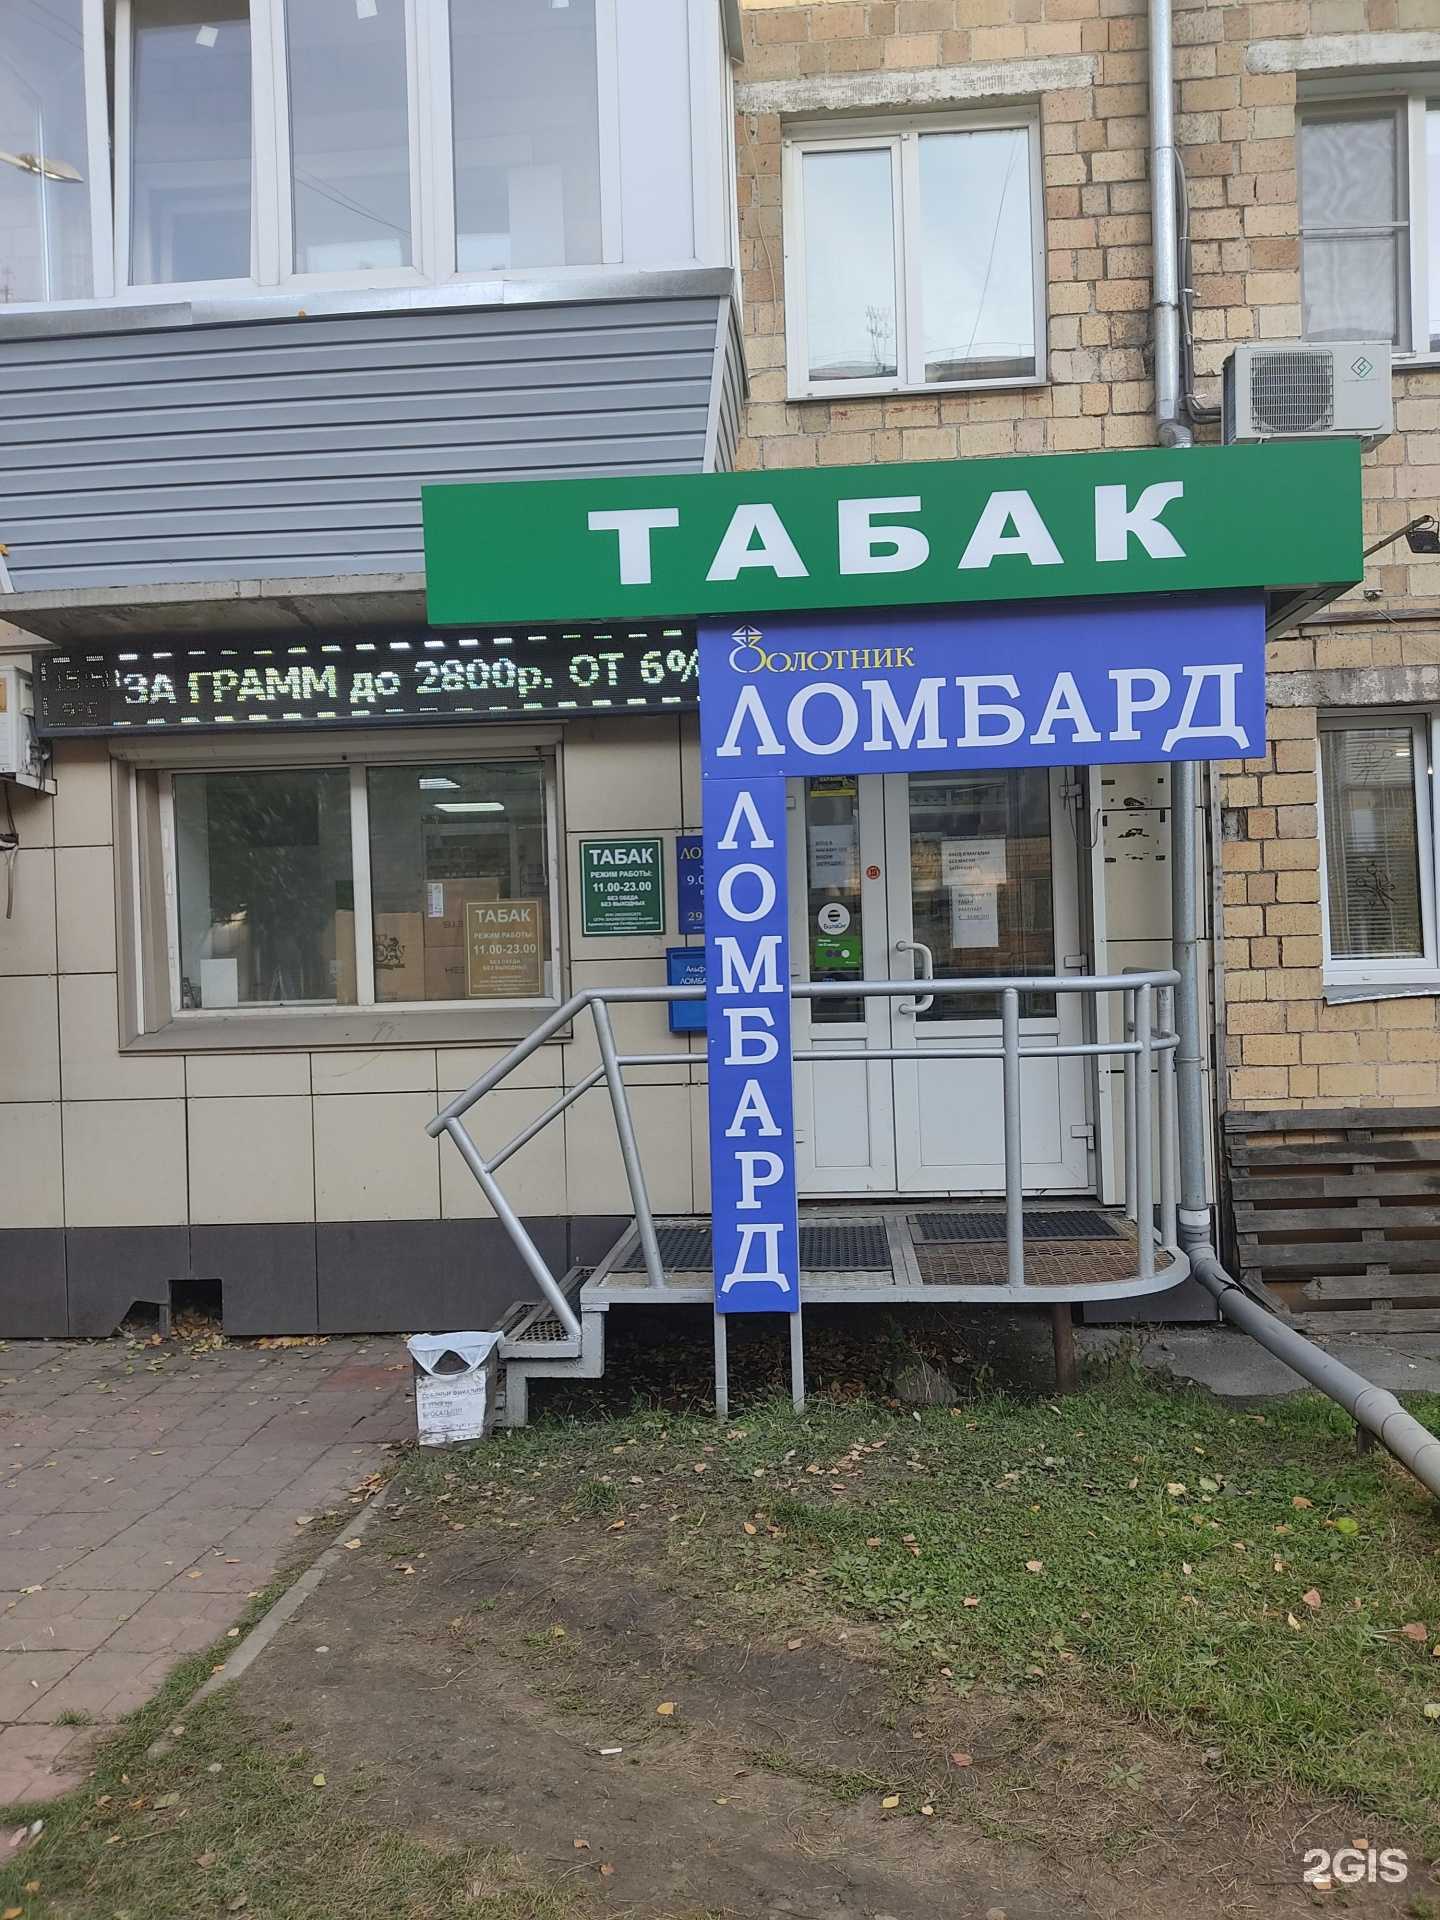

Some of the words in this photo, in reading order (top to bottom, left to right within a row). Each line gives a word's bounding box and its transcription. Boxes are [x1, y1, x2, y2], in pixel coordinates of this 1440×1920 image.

[587, 480, 1187, 586] ТАБАК
[123, 672, 177, 704] ЗА
[187, 663, 338, 703] ГРАММ
[568, 653, 625, 688] ОТ
[715, 662, 1249, 758] ЛОМБАРД
[588, 847, 654, 866] ТАБАК
[590, 871, 618, 879] РЕЖИМ
[592, 881, 652, 893] 11.00-23.00
[475, 908, 532, 923] ТАБАК
[472, 943, 537, 955] 11.00-23.00
[713, 790, 792, 1294] ЛОМБАРД
